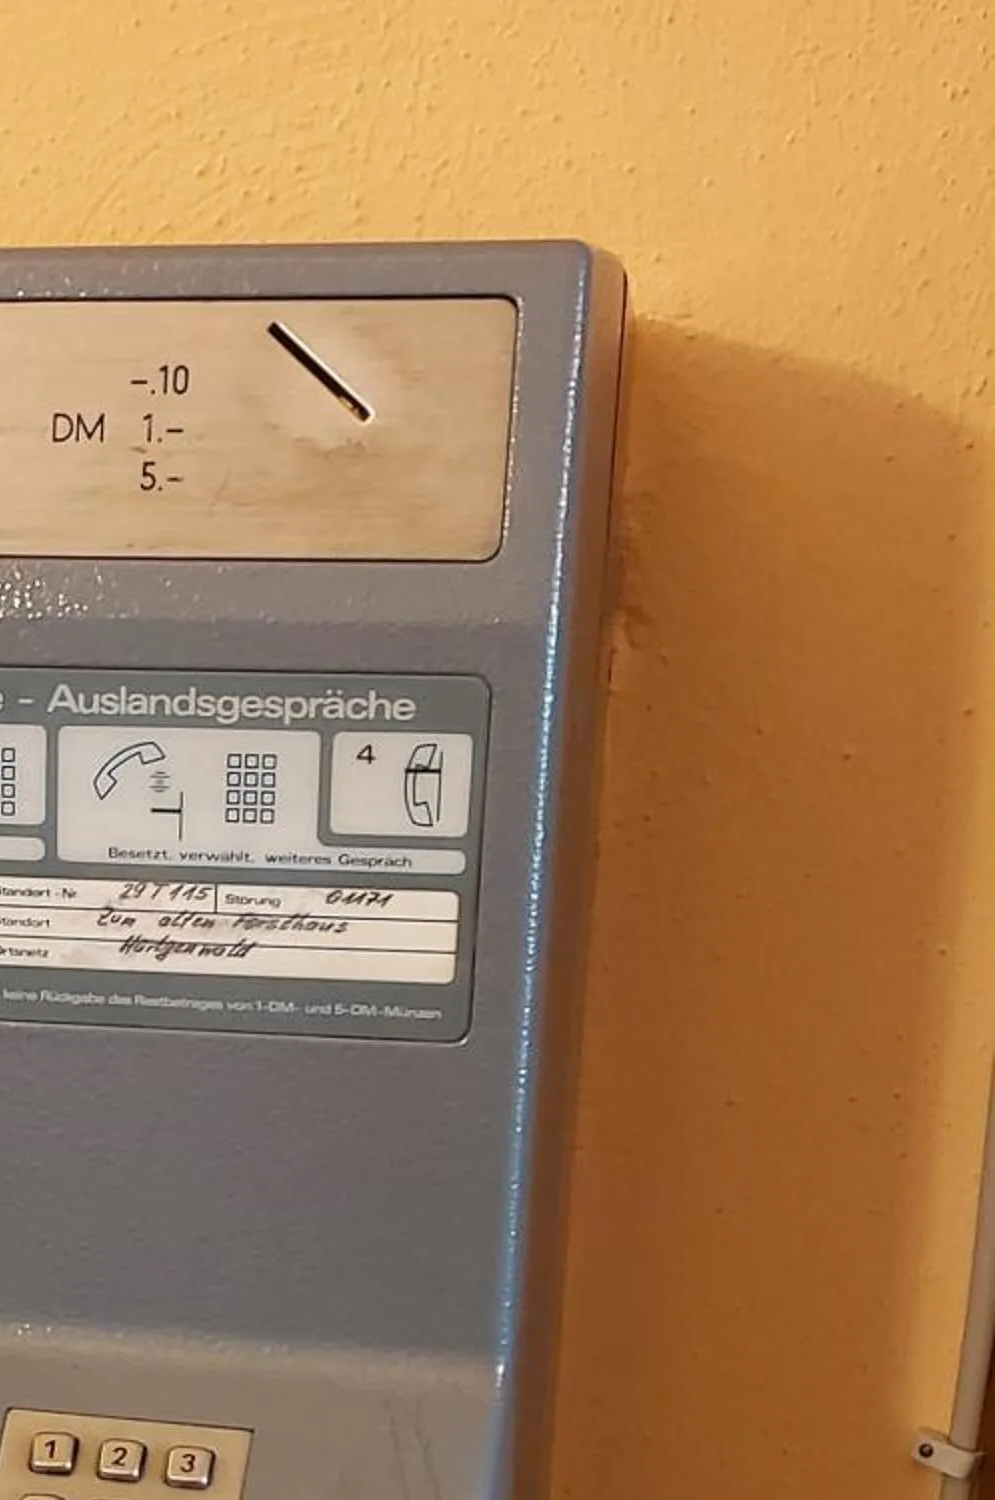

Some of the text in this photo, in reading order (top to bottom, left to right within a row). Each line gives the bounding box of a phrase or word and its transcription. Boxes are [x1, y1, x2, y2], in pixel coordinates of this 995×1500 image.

[52, 412, 185, 443] DM 1.-
[140, 460, 185, 491] 5.-
[46, 682, 417, 725] Auslandsgespräche
[355, 744, 376, 766] 4
[264, 852, 333, 866] weiteres
[43, 1439, 196, 1473] 1 2 3
